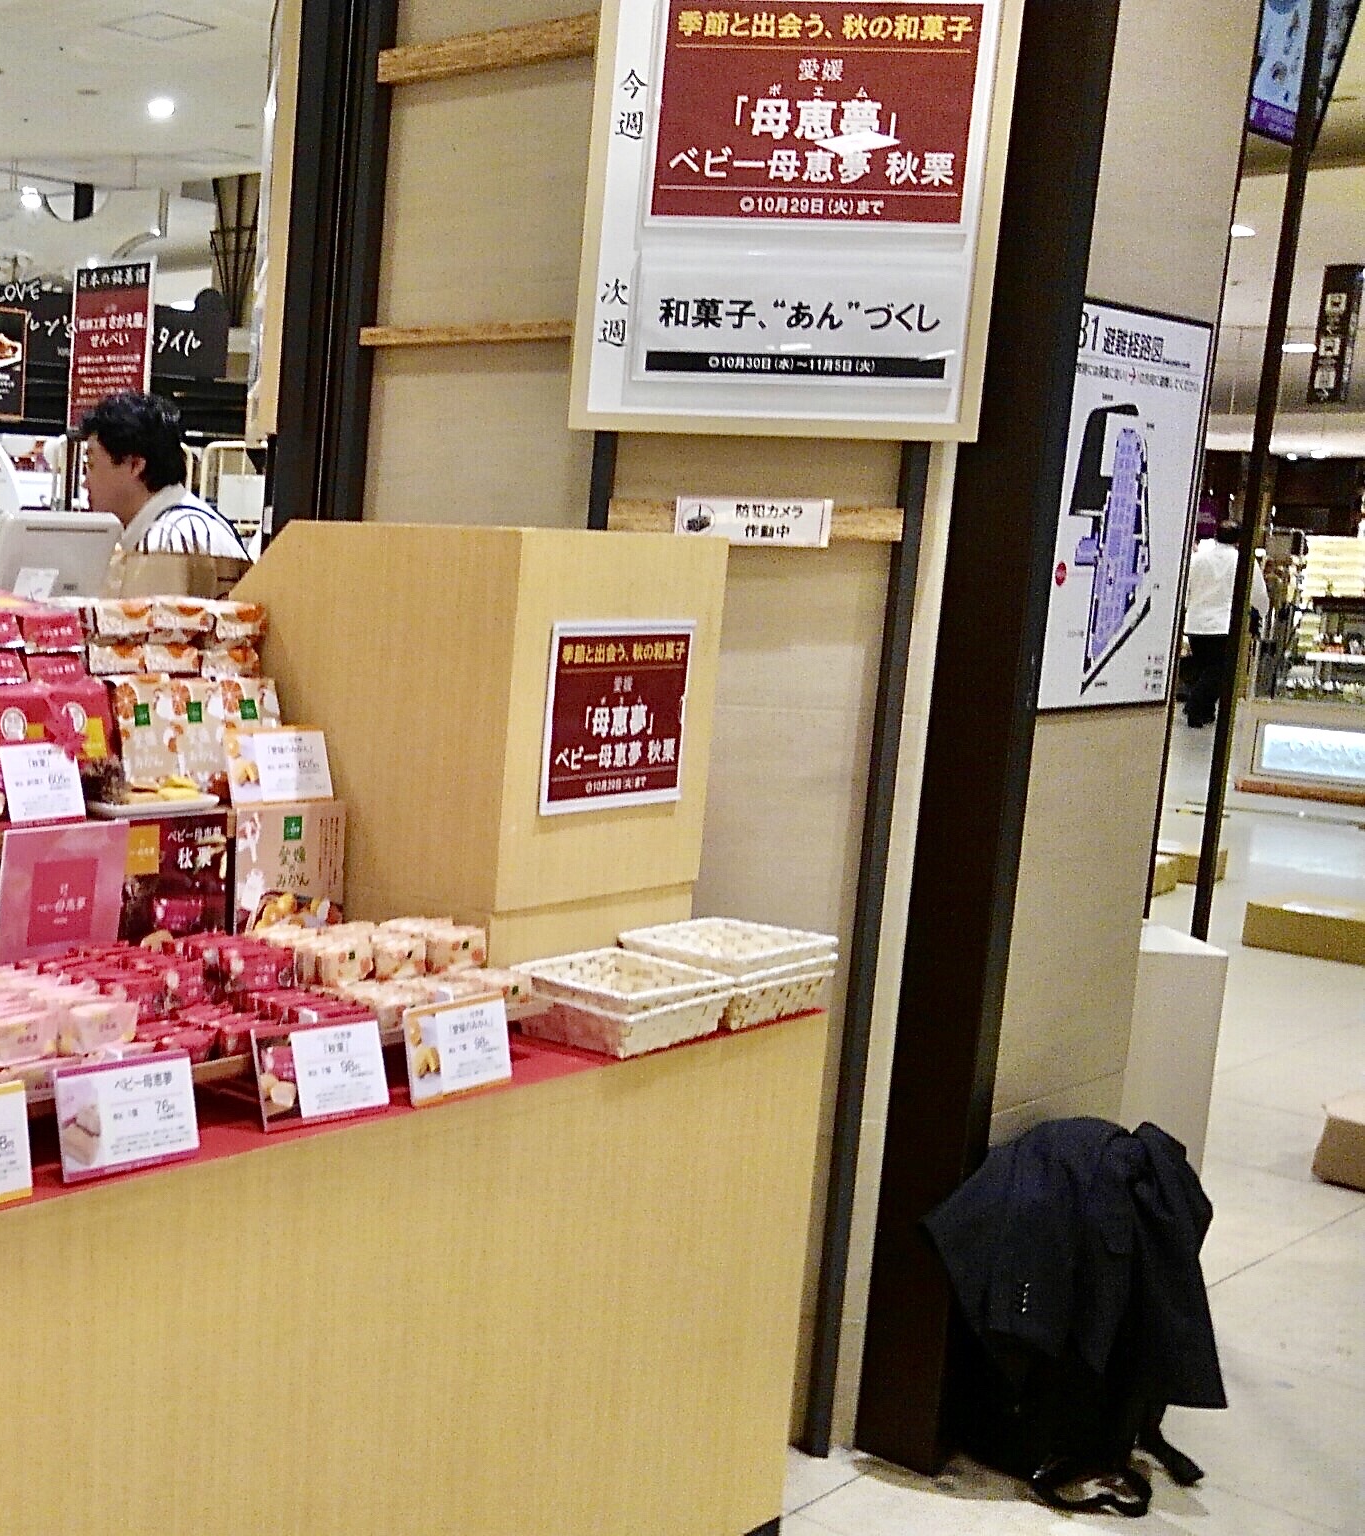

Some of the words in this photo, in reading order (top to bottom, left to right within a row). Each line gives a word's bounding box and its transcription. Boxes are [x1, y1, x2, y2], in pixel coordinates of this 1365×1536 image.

[678, 11, 973, 42] 季節と出会う、秋の和菓子
[798, 58, 844, 81] 愛媛
[615, 69, 648, 139] 今週
[735, 95, 898, 140] 「母恵夢」
[669, 146, 872, 185] ベビー母恵夢
[885, 151, 955, 187] 秋栗
[598, 279, 629, 346] 次週
[736, 503, 804, 519] 防犯カメラ
[745, 524, 791, 538] 作動中
[585, 703, 654, 738] 「母恵夢」
[555, 741, 642, 771] ベビー母恵夢
[647, 738, 676, 764] 秋栗
